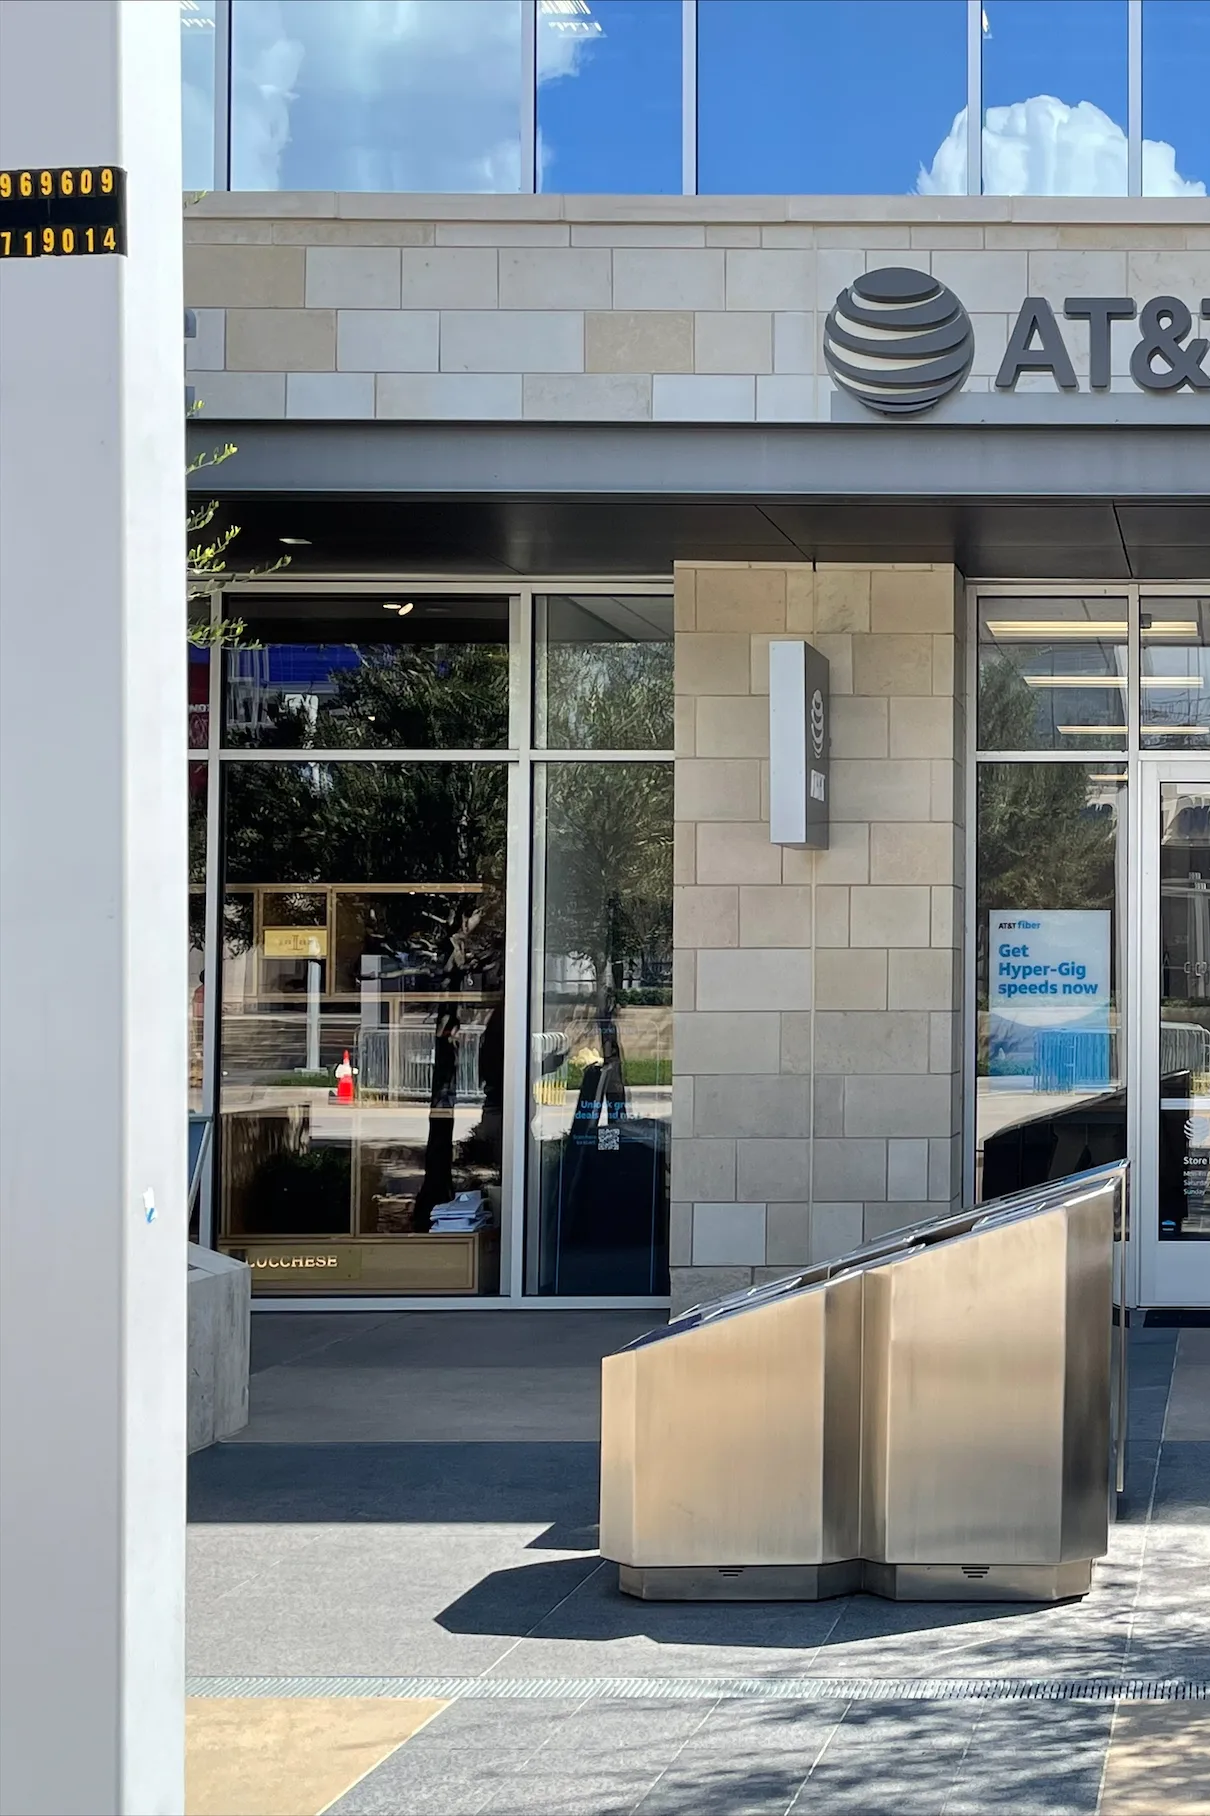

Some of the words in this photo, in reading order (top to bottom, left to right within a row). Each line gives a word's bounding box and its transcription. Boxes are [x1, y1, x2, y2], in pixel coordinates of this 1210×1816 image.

[0, 168, 113, 197] 969609
[0, 228, 116, 256] 719014
[1017, 921, 1040, 929] fiber
[998, 944, 1029, 957] Get
[998, 962, 1086, 979] Hyper-Gig
[998, 980, 1057, 997] speeds
[1062, 983, 1098, 994] now
[581, 1100, 613, 1109] Unlok
[575, 1110, 599, 1119] deals
[1183, 1156, 1207, 1165] Store
